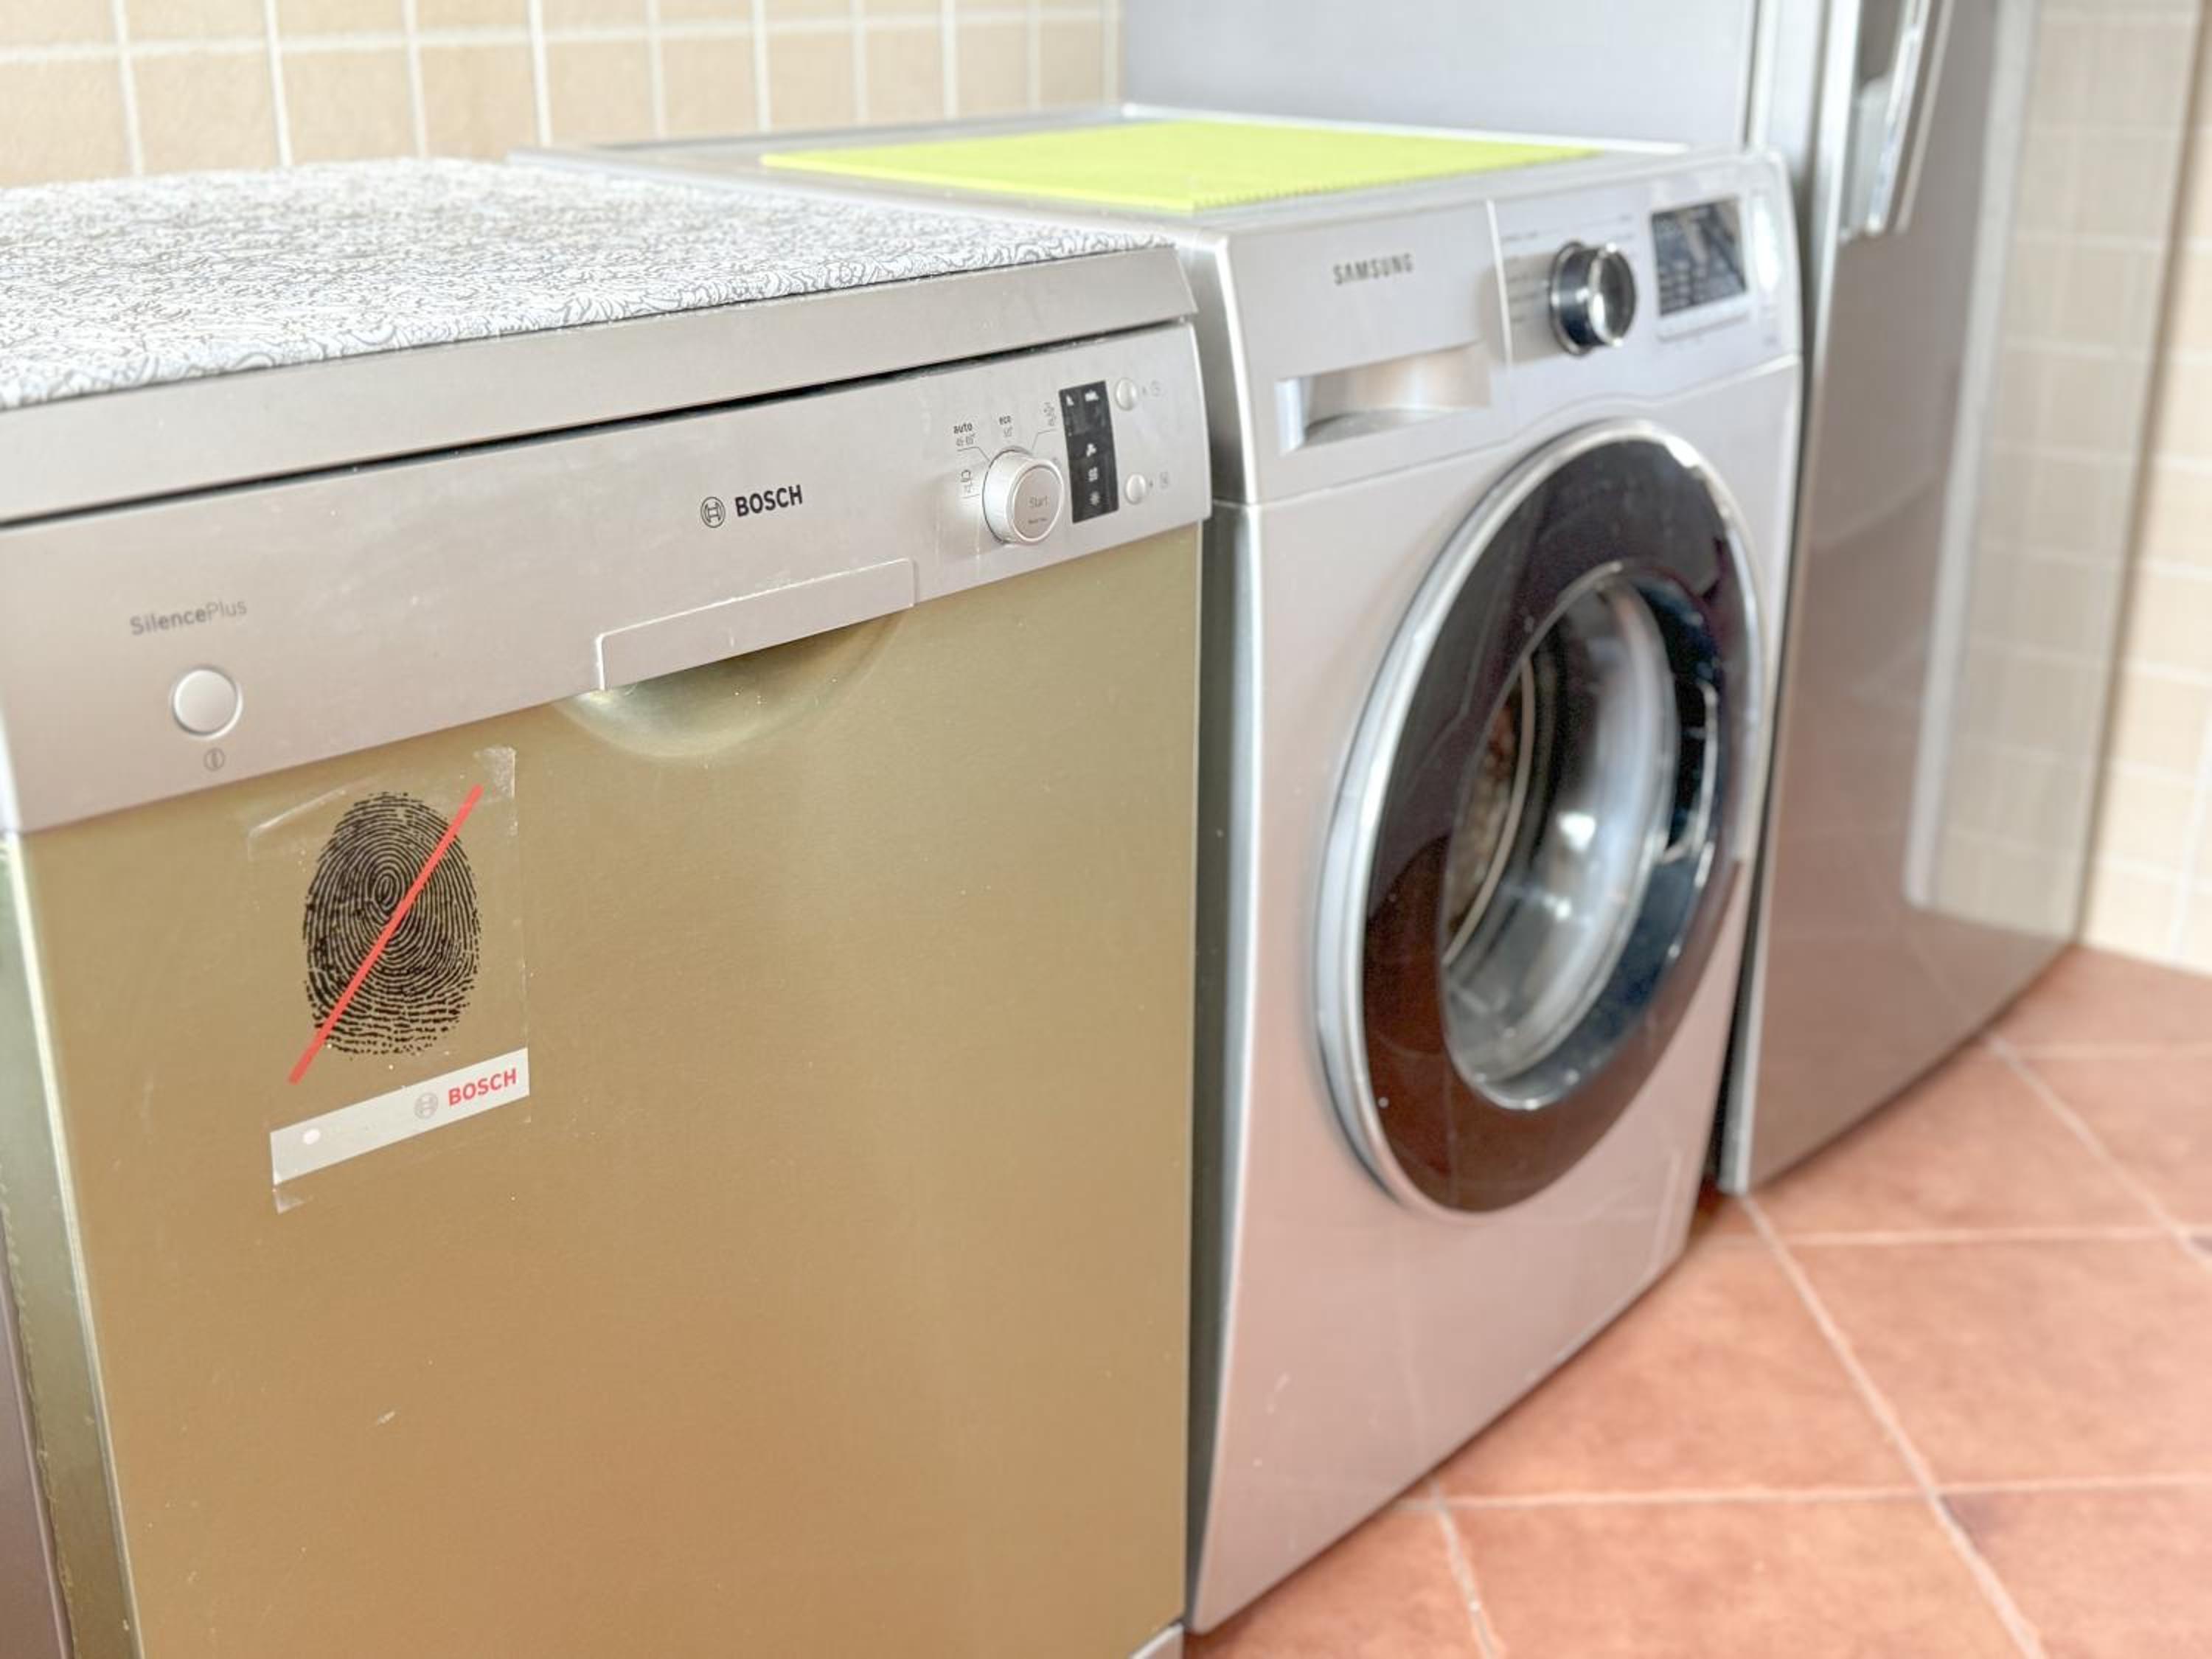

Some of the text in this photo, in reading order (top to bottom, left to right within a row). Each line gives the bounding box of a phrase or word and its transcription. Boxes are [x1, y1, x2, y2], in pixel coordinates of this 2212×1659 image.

[1333, 252, 1413, 286] SAMSUNG
[953, 422, 973, 434] auto
[999, 415, 1011, 425] eco
[735, 484, 803, 518] BOSCH
[130, 598, 248, 636] SilencePlus
[448, 1068, 518, 1106] BOSCH
